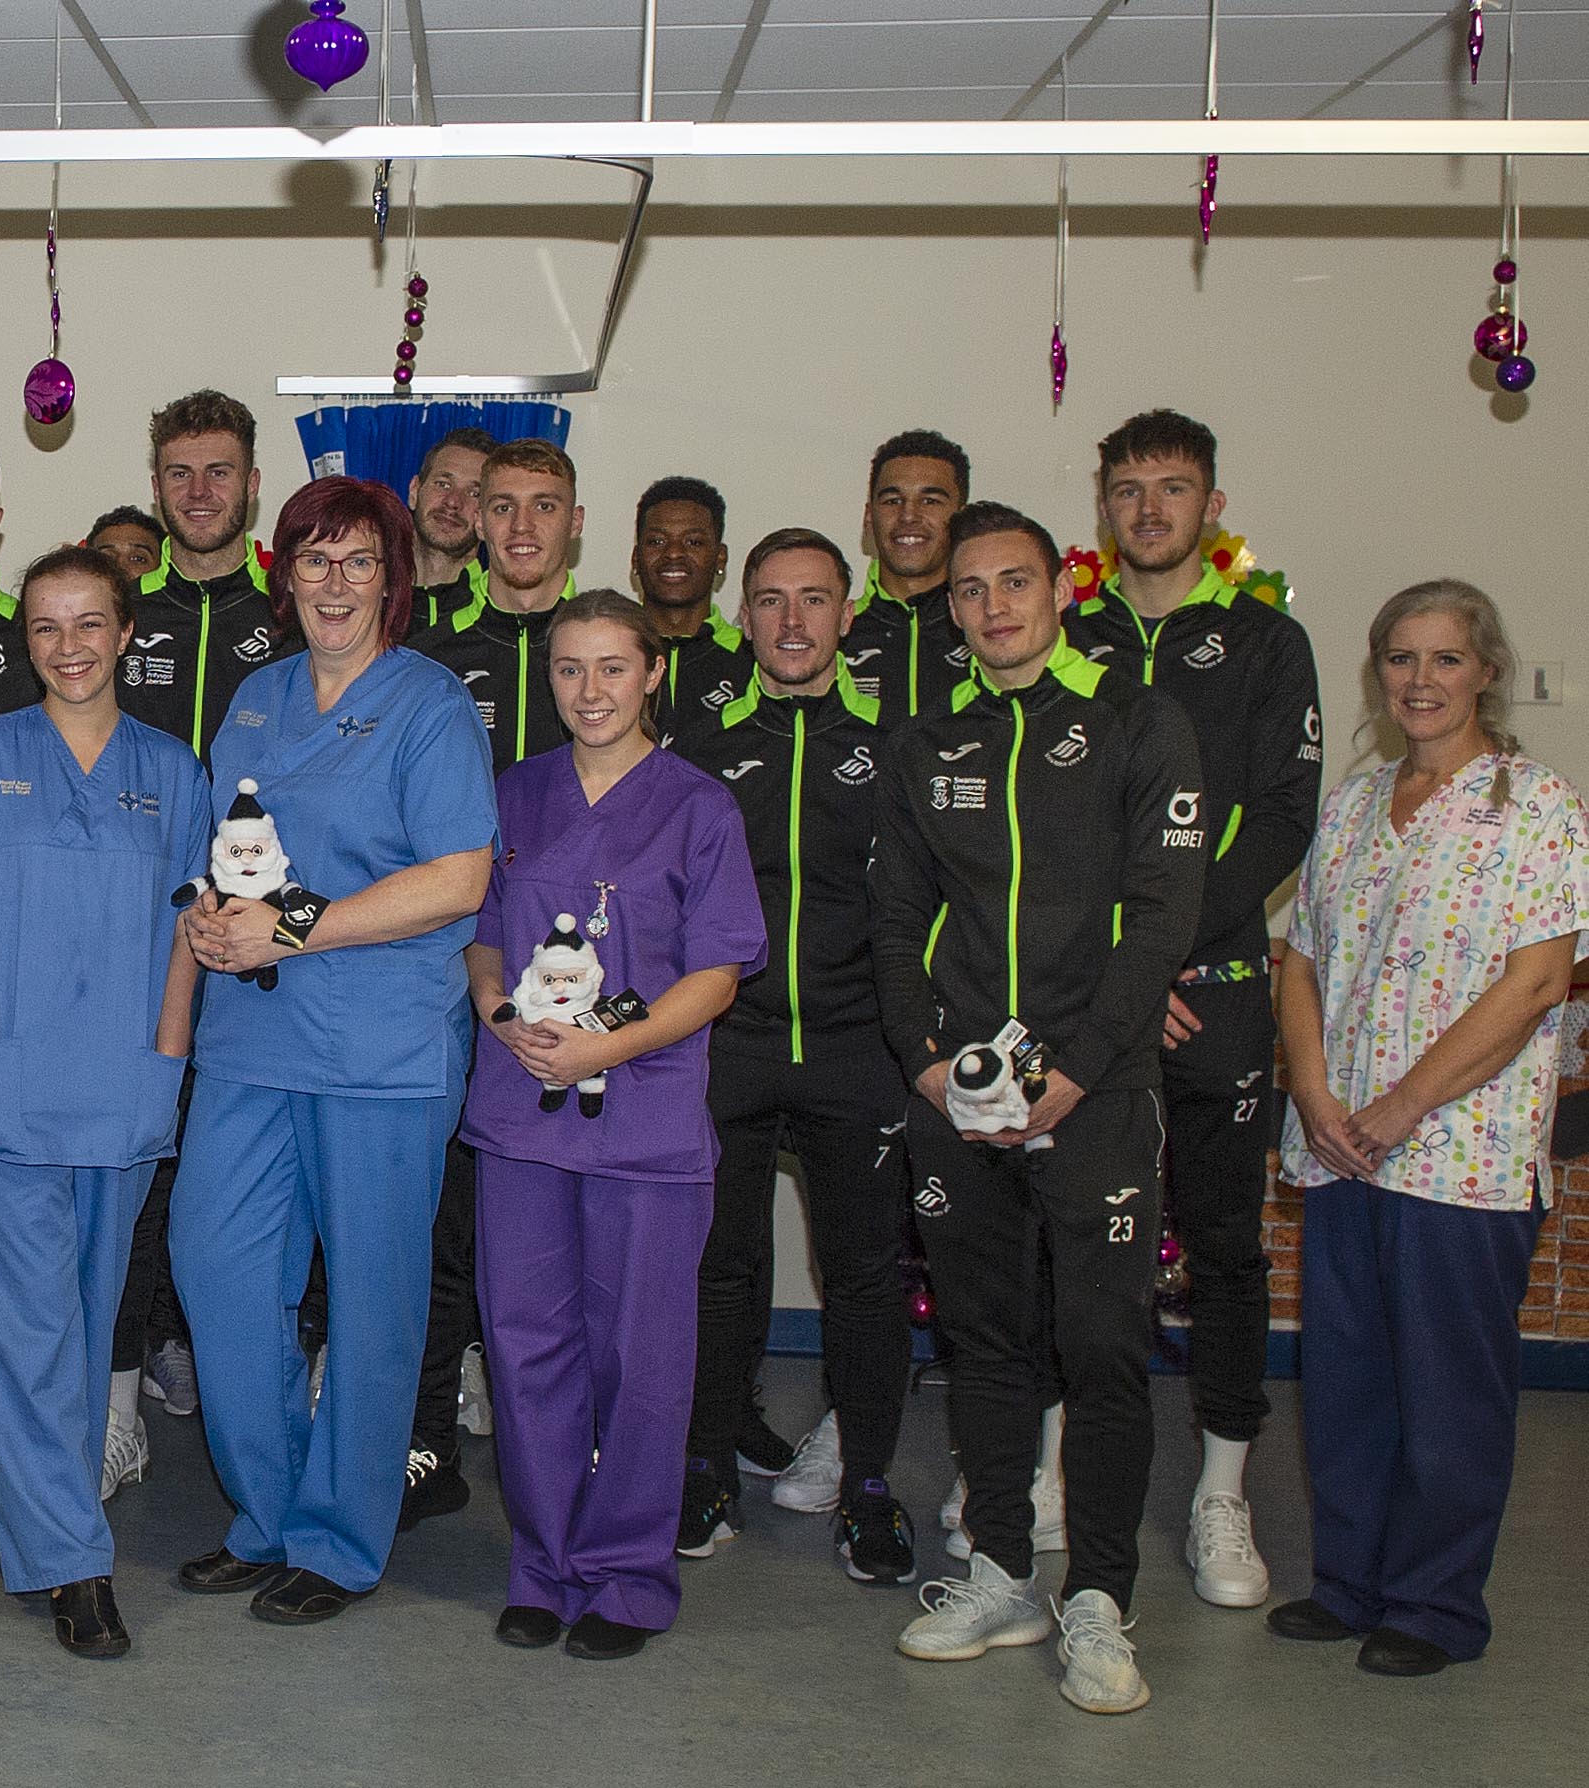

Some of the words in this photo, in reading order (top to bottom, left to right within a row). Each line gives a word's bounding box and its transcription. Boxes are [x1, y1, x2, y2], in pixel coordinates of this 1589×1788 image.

[1161, 829, 1205, 848] YOBET
[1234, 1098, 1259, 1123] 27
[875, 1145, 891, 1169] 7
[1108, 1215, 1135, 1243] 23
